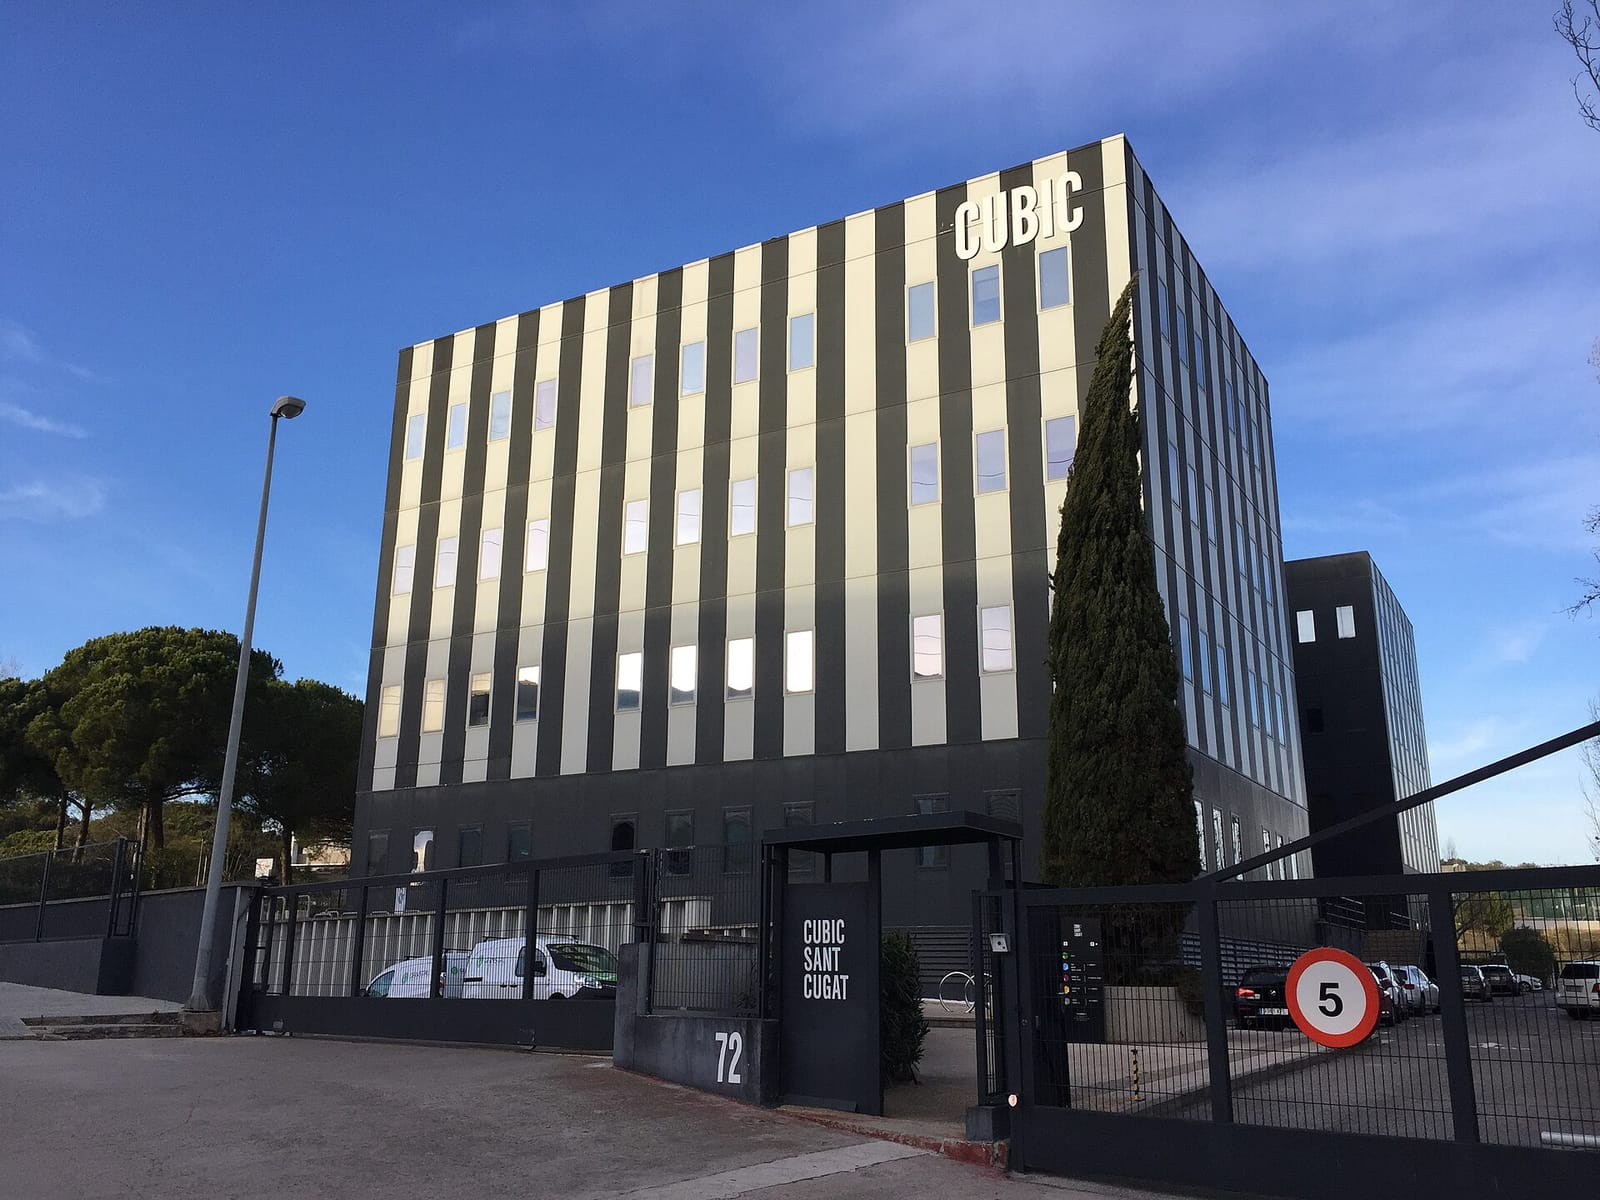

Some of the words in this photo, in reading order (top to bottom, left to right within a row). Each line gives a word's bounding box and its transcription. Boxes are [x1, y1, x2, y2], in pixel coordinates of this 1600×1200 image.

[955, 171, 1084, 260] CUBIC
[803, 919, 845, 944] CUBIC
[803, 946, 841, 972] SANT
[803, 974, 849, 1000] CUGAT
[1318, 982, 1344, 1017] 5
[715, 1032, 743, 1084] 72
